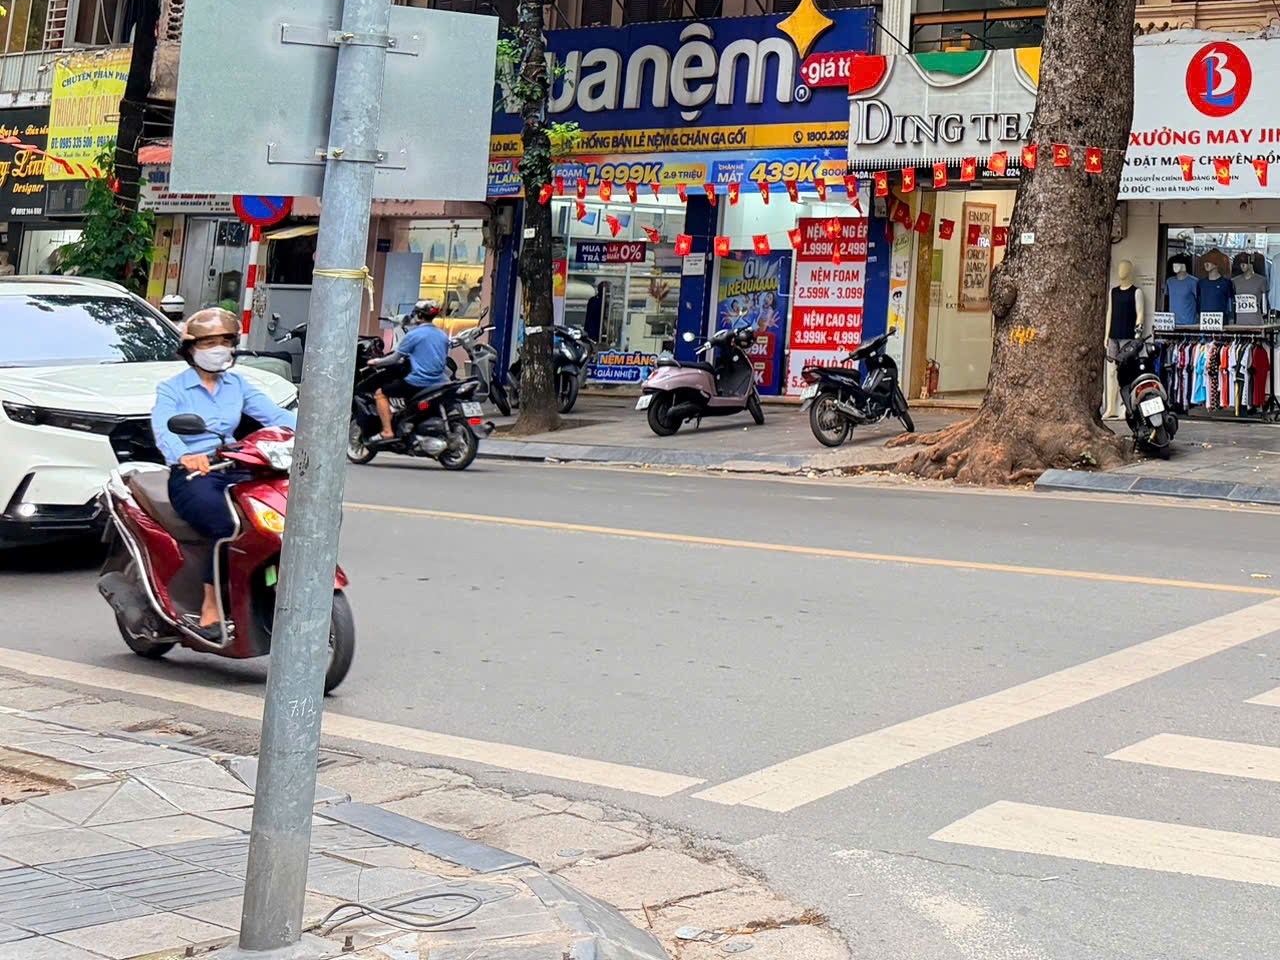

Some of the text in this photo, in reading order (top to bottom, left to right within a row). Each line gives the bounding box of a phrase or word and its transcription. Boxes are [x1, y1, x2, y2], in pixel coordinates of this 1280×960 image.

[808, 57, 836, 84] giá
[854, 98, 964, 145] DING
[712, 132, 727, 145] GA
[1129, 126, 1202, 146] XƯỞNG
[1207, 129, 1253, 144] MAY
[1133, 156, 1158, 169] ĐẶT
[750, 161, 818, 184] 439K
[1006, 168, 1020, 177] 024
[13, 183, 44, 195] Designer
[840, 241, 867, 255] 2.499
[810, 268, 860, 284] NỆM FOAM
[799, 287, 830, 300] 2.599K
[803, 311, 861, 328] NỆM CAO SU
[795, 330, 862, 344] 3.999K 4.999
